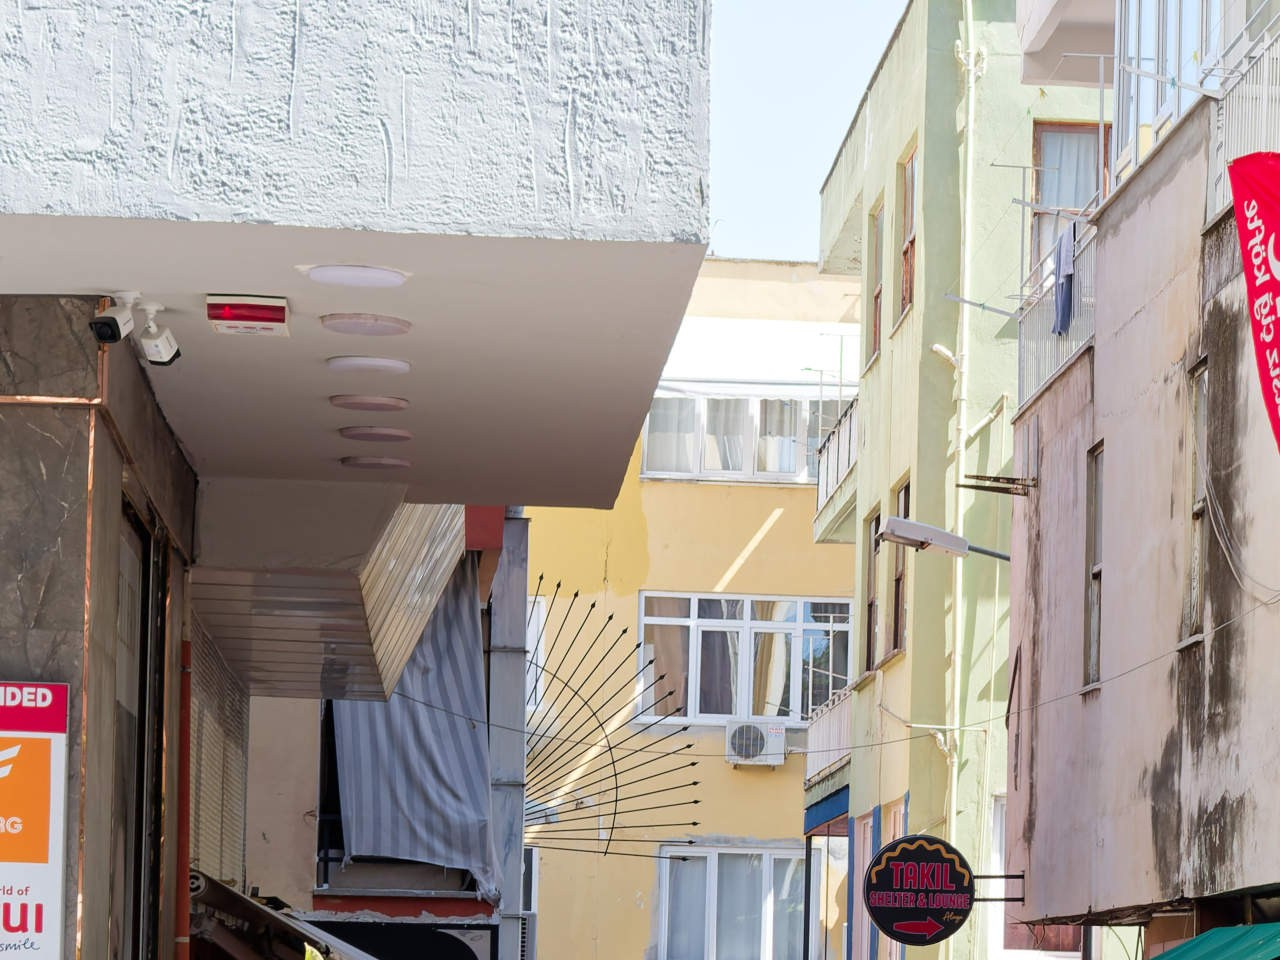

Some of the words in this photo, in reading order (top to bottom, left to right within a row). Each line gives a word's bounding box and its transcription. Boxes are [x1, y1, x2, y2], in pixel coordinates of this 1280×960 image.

[889, 861, 956, 891] TAKIL
[17, 886, 31, 896] of
[869, 890, 916, 908] SHELTER
[917, 892, 928, 909] &
[928, 893, 970, 910] LOUNGE
